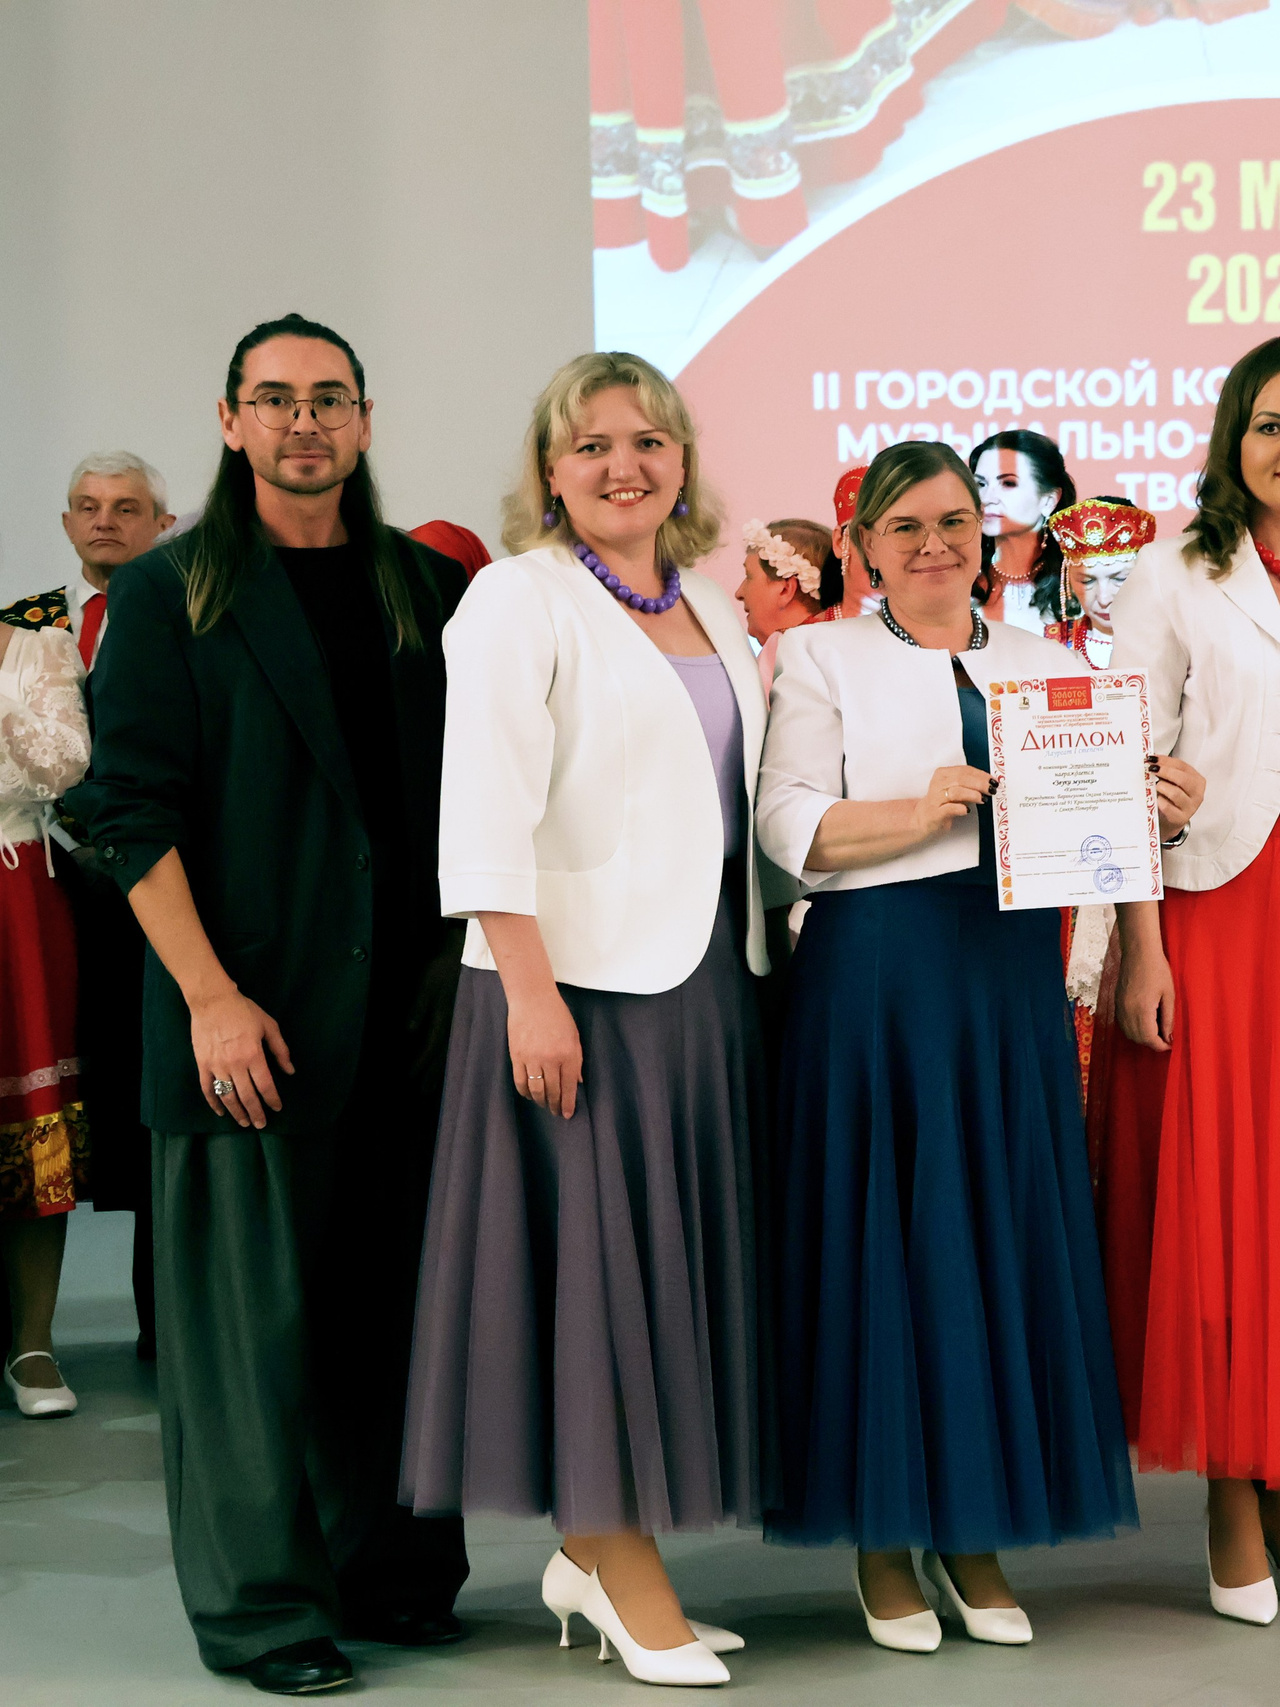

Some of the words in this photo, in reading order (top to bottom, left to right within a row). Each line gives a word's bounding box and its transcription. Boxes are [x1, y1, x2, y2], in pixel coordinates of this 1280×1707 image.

[1142, 160, 1216, 232] 23
[812, 371, 840, 410] II
[855, 359, 1156, 415] ГОРОДСКОЙ
[1052, 690, 1087, 699] ЗОЛОТОЕ
[1052, 698, 1088, 708] ЯБЛОЧКО
